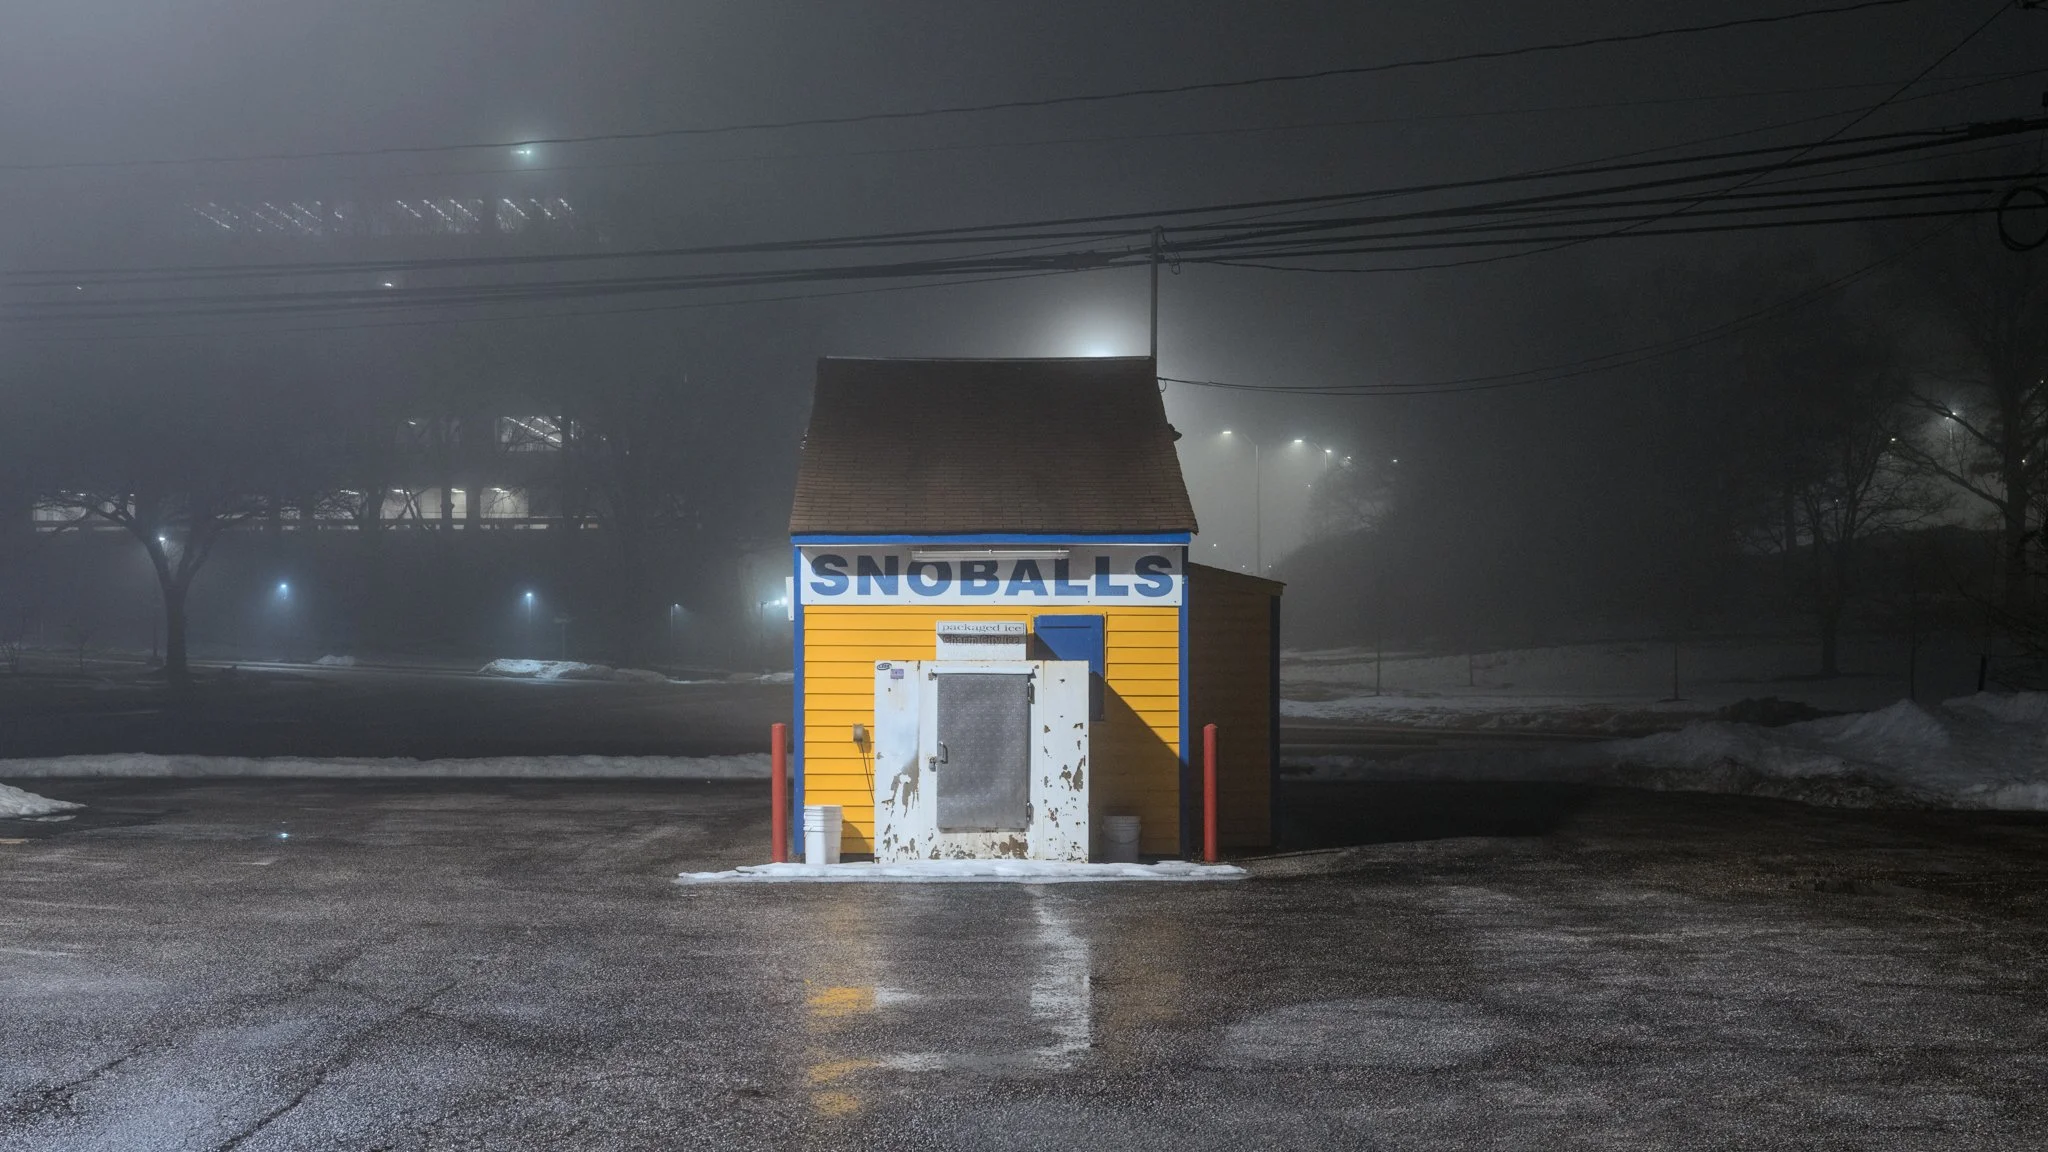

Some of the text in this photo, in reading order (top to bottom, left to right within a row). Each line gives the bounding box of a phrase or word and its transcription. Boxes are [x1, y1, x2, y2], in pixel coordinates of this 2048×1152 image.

[810, 554, 1174, 597] SNOBALLS
[943, 624, 1021, 633] packaged ice
